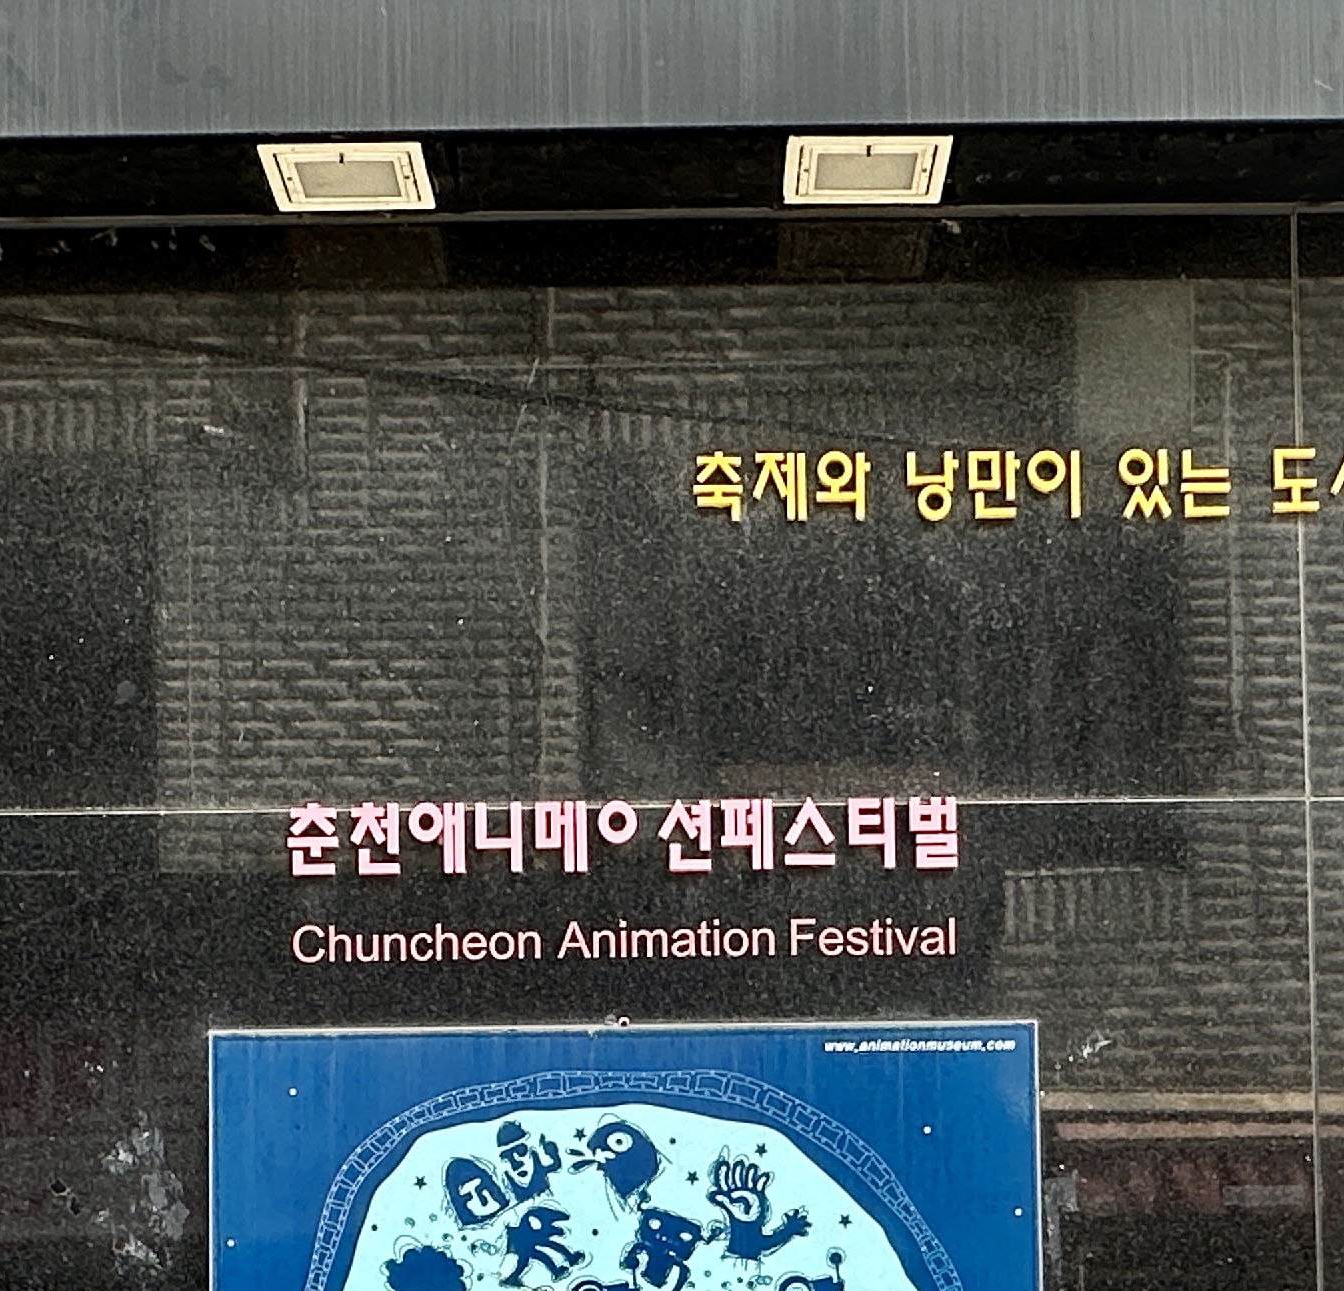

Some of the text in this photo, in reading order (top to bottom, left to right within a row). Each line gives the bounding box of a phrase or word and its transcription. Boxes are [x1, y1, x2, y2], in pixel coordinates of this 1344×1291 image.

[692, 450, 870, 522] 축제와
[906, 448, 1081, 522] 낭만이
[1117, 446, 1232, 520] 있는
[292, 915, 957, 964] Chuncheon Animation Festival
